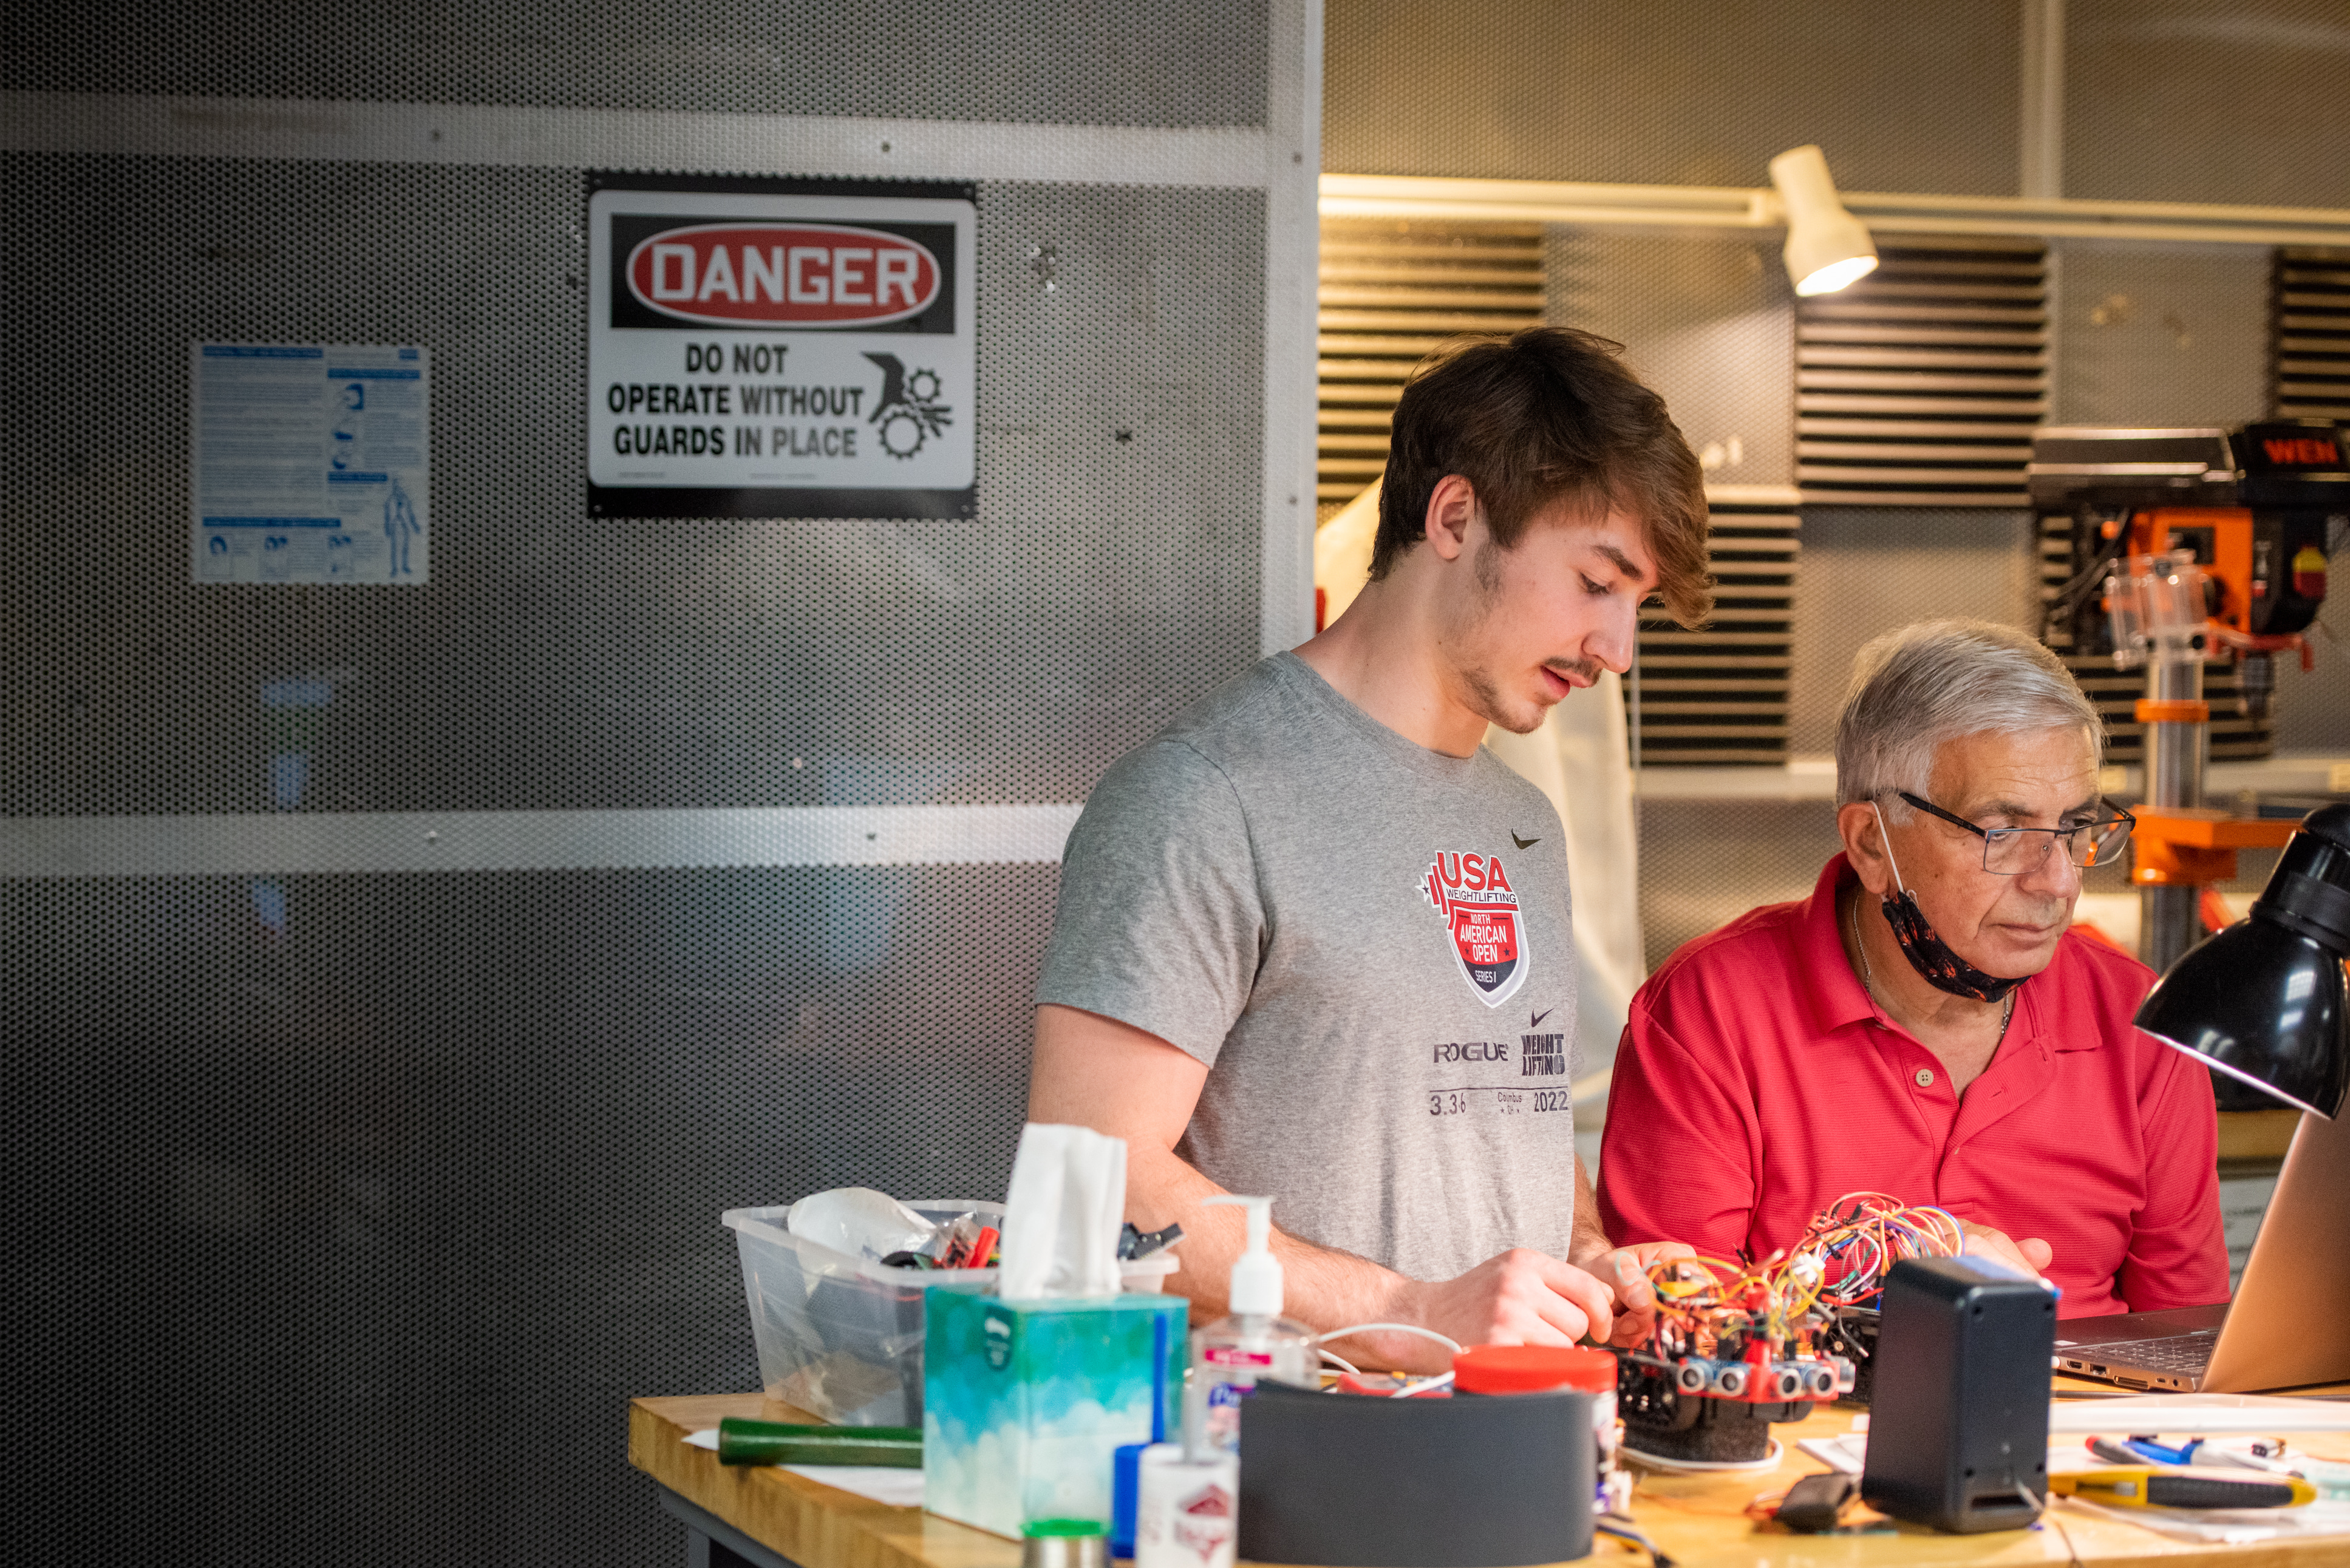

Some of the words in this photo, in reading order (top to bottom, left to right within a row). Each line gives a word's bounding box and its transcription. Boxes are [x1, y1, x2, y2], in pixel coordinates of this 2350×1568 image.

[650, 243, 919, 305] DANGER
[686, 342, 723, 373] DO
[732, 344, 789, 375] NOT
[608, 383, 731, 415] OPERATE
[739, 386, 863, 416] WITHOUT
[614, 426, 725, 456] GUARDS
[734, 427, 763, 456] IN
[772, 428, 857, 458] PLACE
[1437, 852, 1512, 892] USA
[1446, 888, 1517, 903] WEIGHTLIFTING
[1470, 913, 1491, 925] NORTH
[1460, 923, 1508, 943] AMERICAN
[1472, 944, 1498, 962] OPEN
[1474, 969, 1493, 983] SERIES
[1433, 1042, 1508, 1063] ROGUE
[1520, 1033, 1564, 1055] WEIGHT
[1521, 1054, 1565, 1076] LIFTING
[1534, 1090, 1568, 1112] 2022
